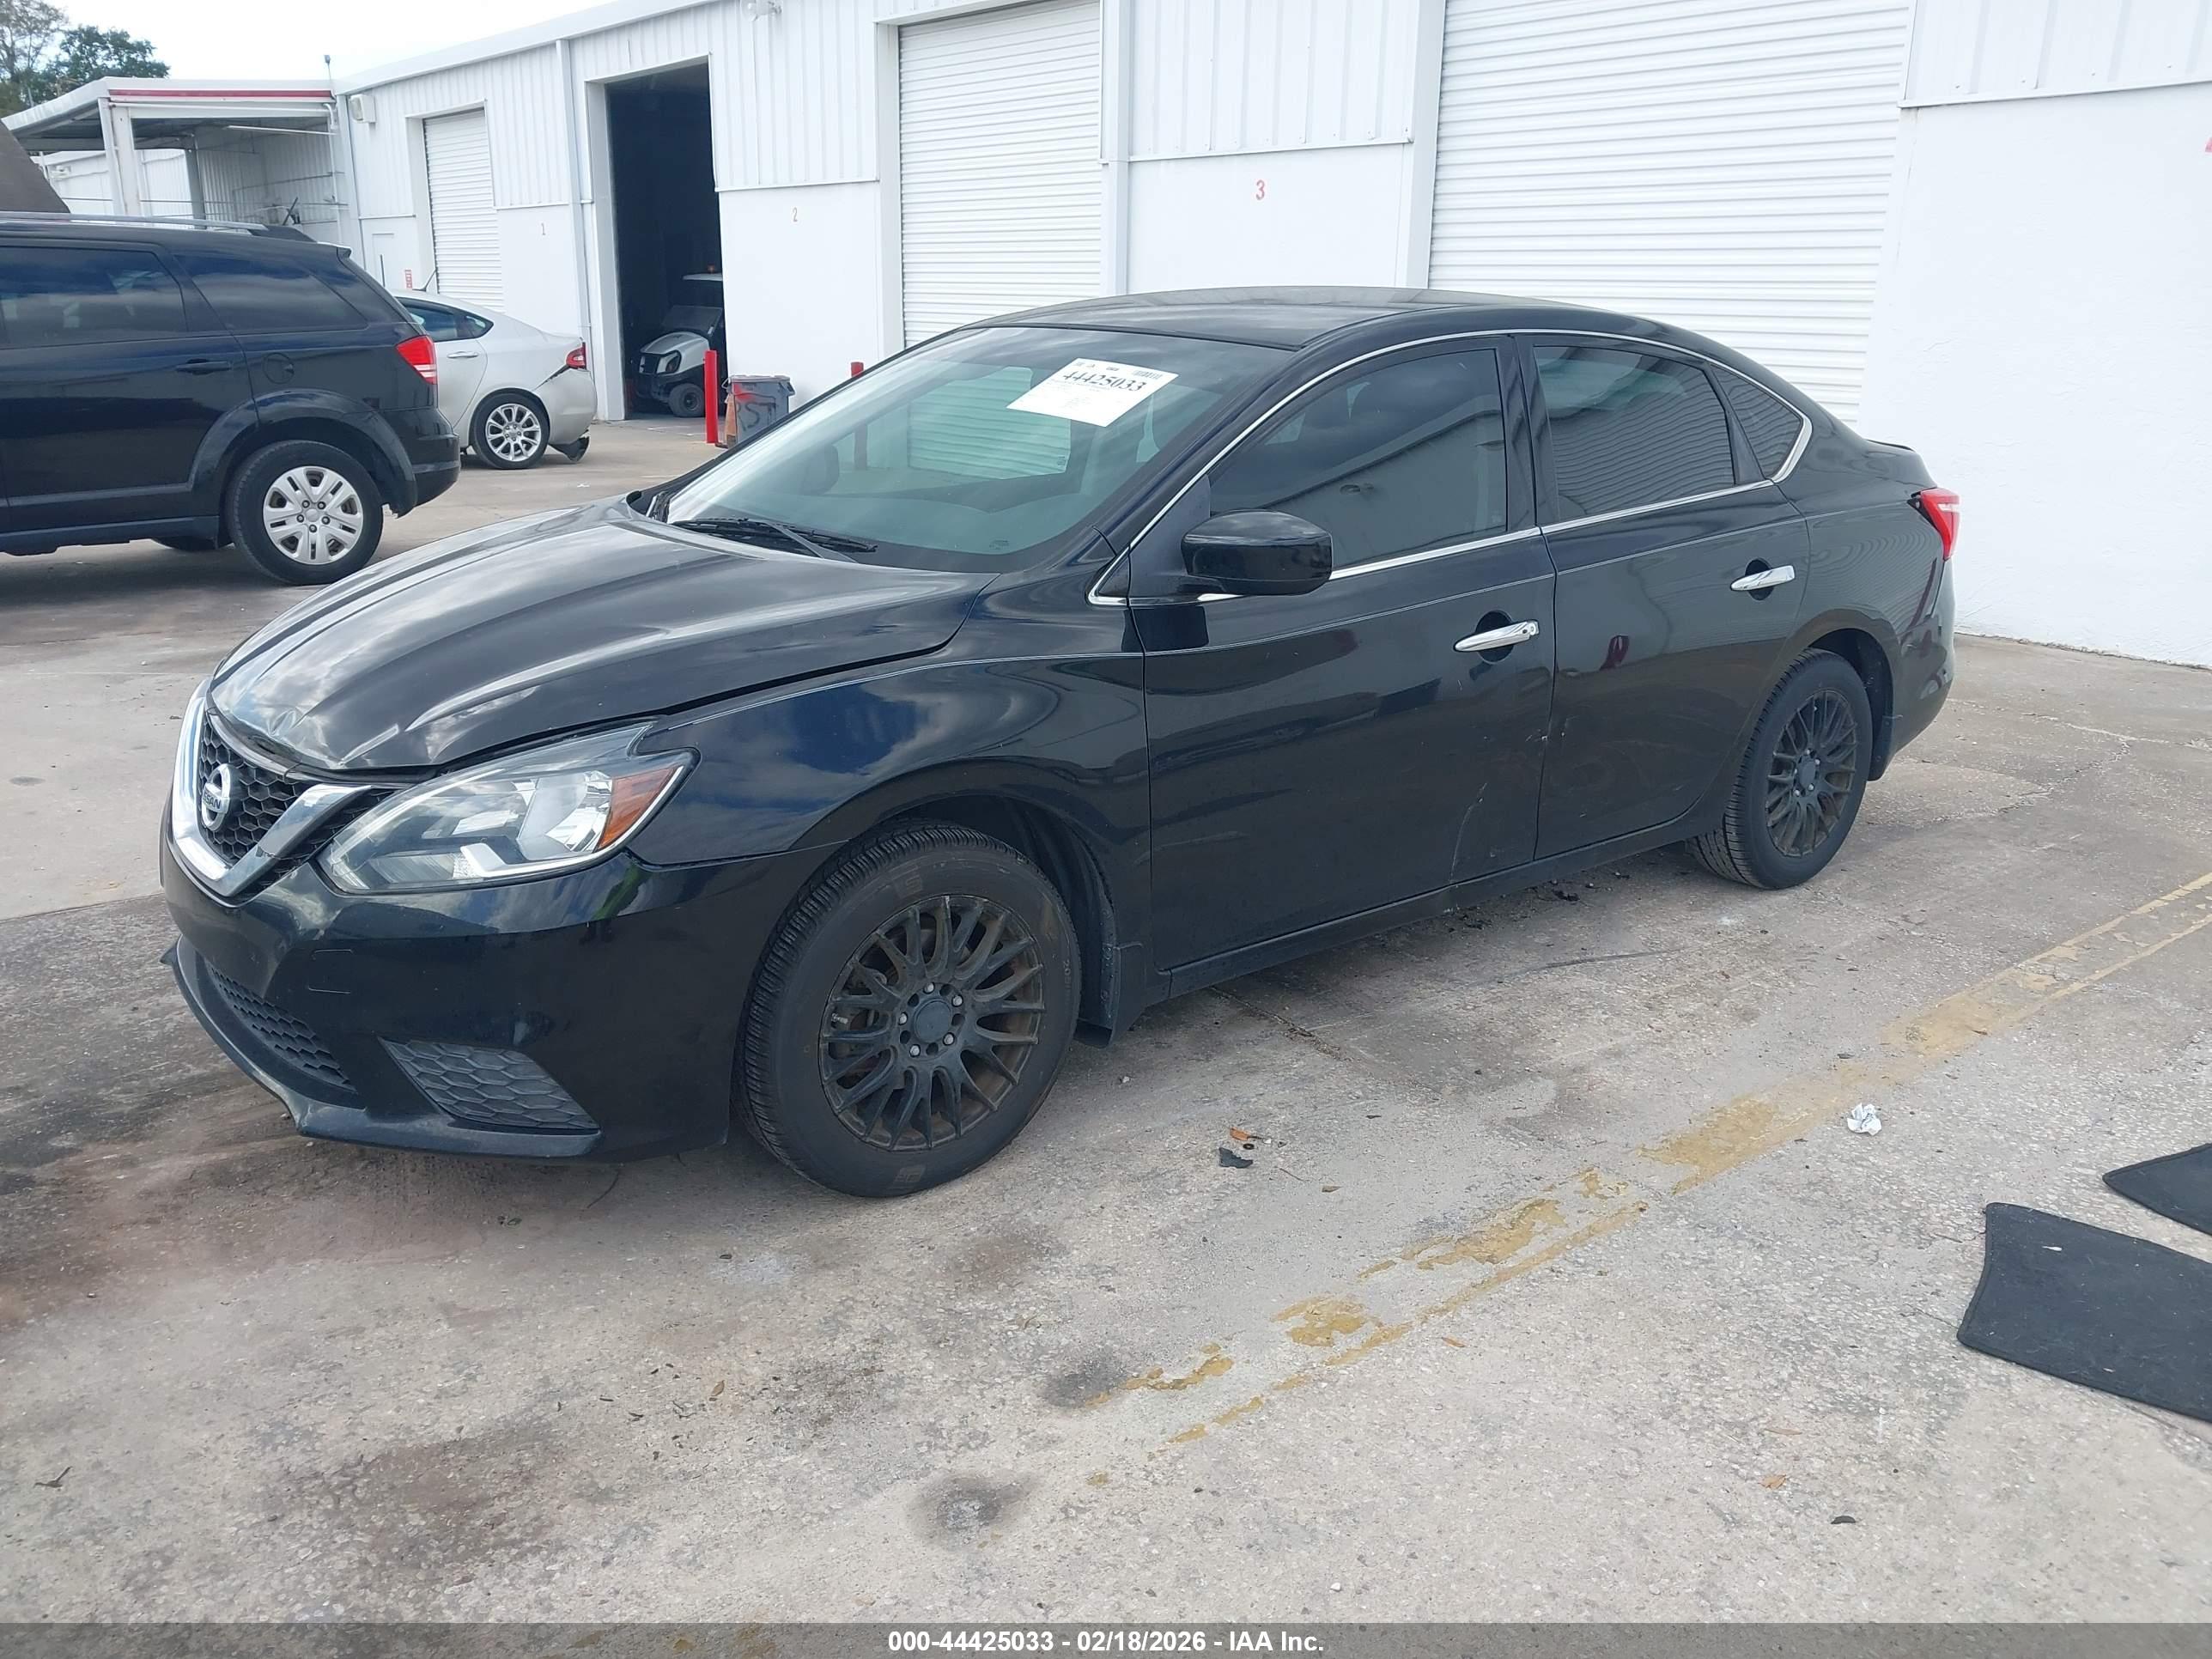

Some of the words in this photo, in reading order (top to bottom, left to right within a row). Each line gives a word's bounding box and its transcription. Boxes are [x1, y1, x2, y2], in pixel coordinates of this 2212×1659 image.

[1255, 179, 1266, 201] 3
[792, 206, 799, 222] 2
[1063, 371, 1146, 391] 44425033
